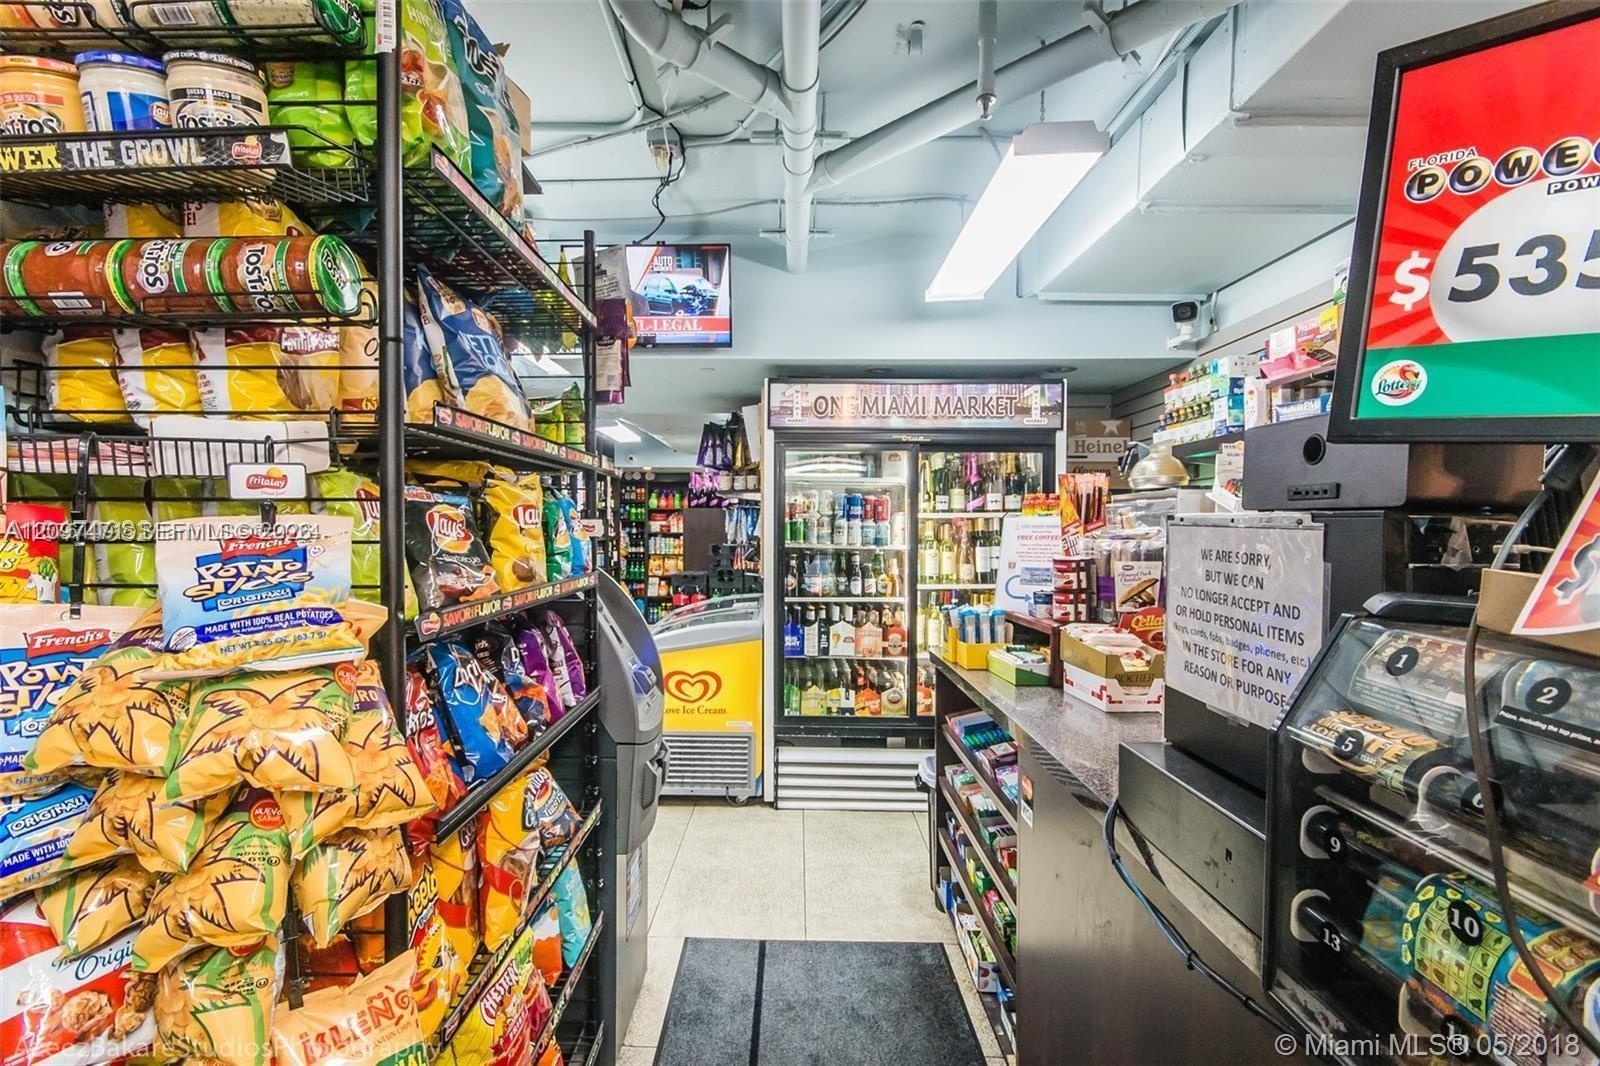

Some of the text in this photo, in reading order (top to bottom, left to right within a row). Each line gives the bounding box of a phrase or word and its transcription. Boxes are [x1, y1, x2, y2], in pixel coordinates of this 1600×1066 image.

[66, 140, 116, 170] THE
[1407, 147, 1477, 170] FLORIDA
[653, 255, 673, 267] AUTO
[861, 395, 927, 416] MIAMI
[933, 395, 1019, 416] MARKET
[196, 558, 303, 582] POTATO
[1200, 548, 1272, 571] WE ARE SORRY,
[182, 570, 315, 602] STICKS
[1204, 569, 1264, 590] BUT WE CAN
[1180, 585, 1301, 621] NO LONGER ACCEPT AND
[204, 623, 229, 635] MADE
[229, 619, 252, 632] WITH
[252, 617, 274, 627] 100%
[274, 613, 295, 624] REAL
[1175, 604, 1305, 647] OR HOLD PERSONAL ITEMS
[31, 630, 106, 649] French's
[220, 644, 237, 655] NET
[1182, 640, 1292, 685] IN THE STORE FOR ANY
[1254, 643, 1289, 665] phones,
[1394, 653, 1409, 669] 1
[1183, 661, 1287, 708] REASON OR PURPOSE
[1535, 685, 1559, 705] 2
[682, 705, 696, 715] Ice
[1341, 736, 1358, 752] 5
[11, 796, 86, 833] ORIGINAL
[3, 852, 31, 868] MADE
[31, 845, 55, 859] WITH
[1329, 837, 1341, 853] 9
[1450, 907, 1480, 939] 10
[1322, 925, 1341, 953] 13
